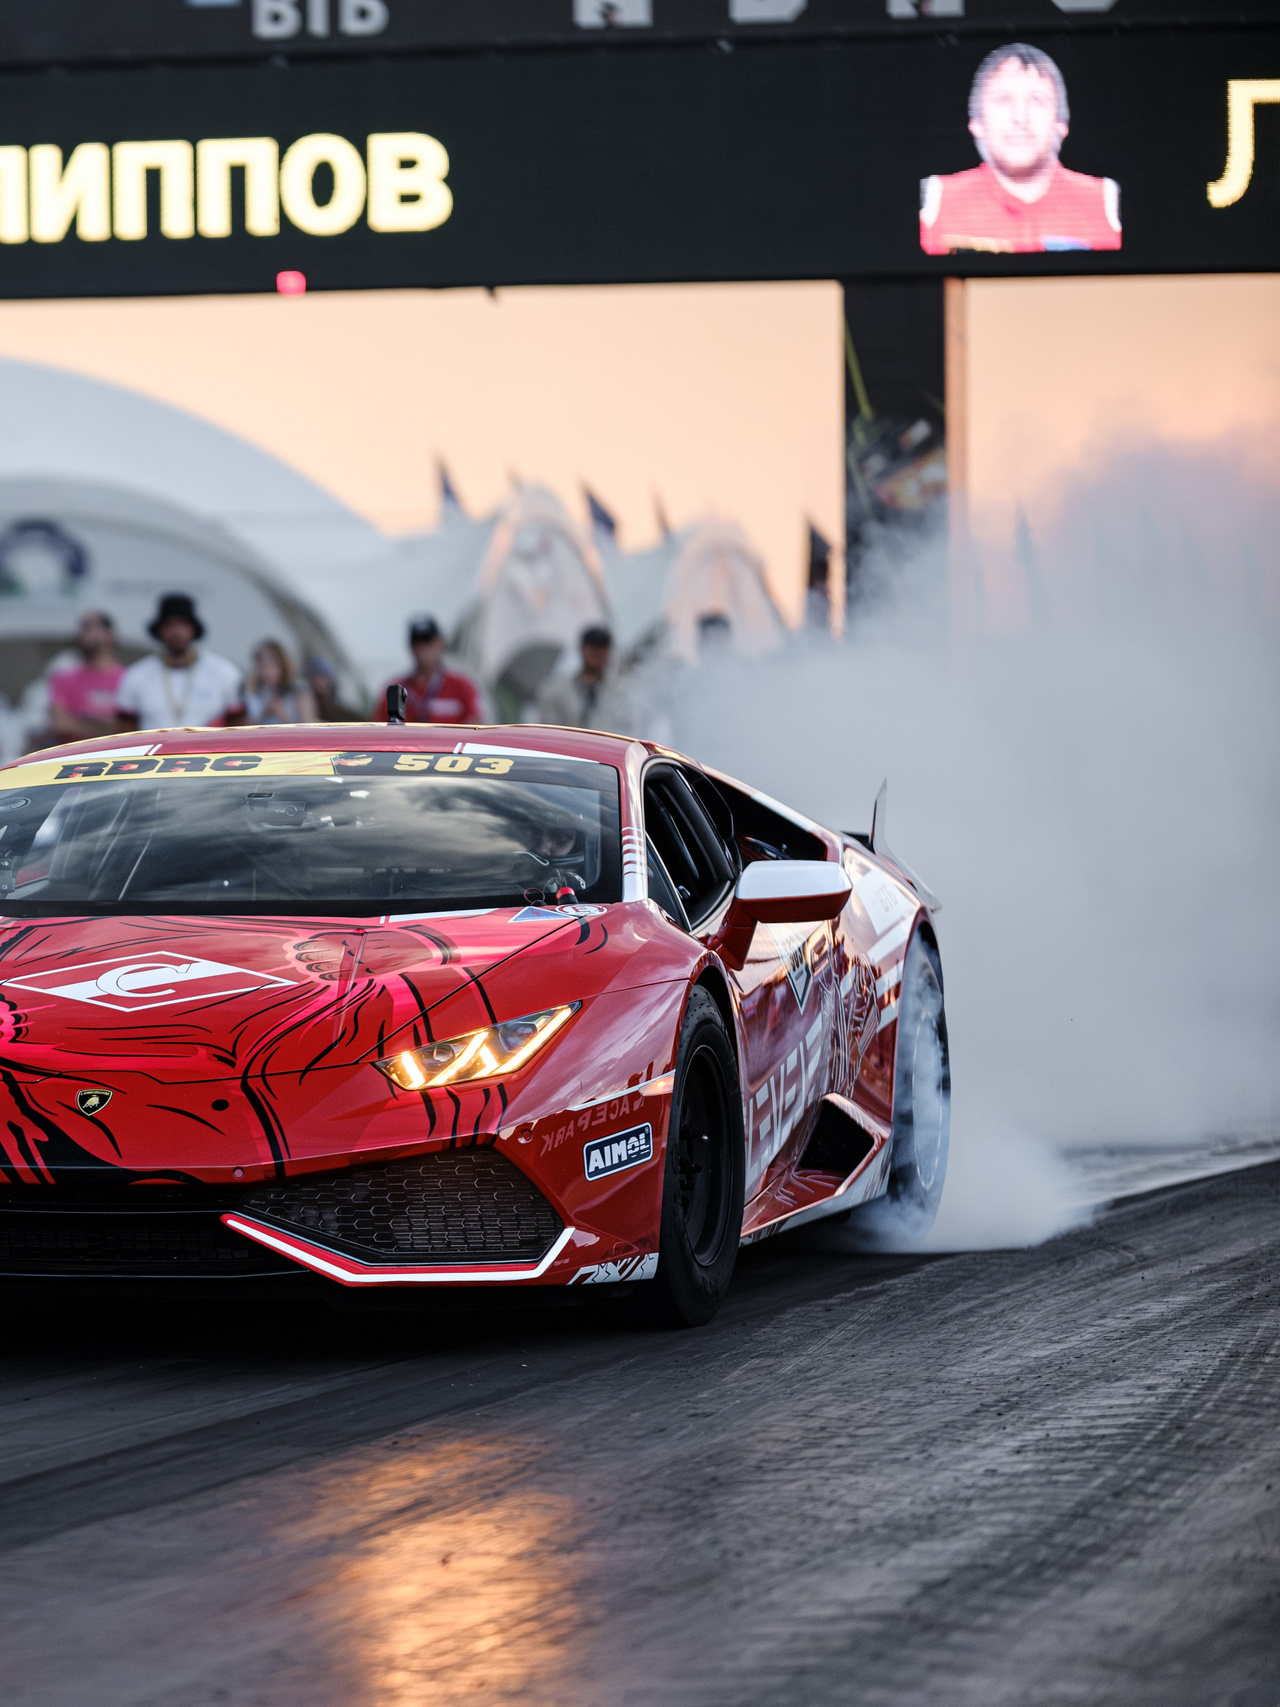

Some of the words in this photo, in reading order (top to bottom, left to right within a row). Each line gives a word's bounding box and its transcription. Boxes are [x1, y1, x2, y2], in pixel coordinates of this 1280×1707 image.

[54, 756, 263, 779] RDRC
[393, 755, 514, 774] 503
[588, 1132, 650, 1173] AIMOL
